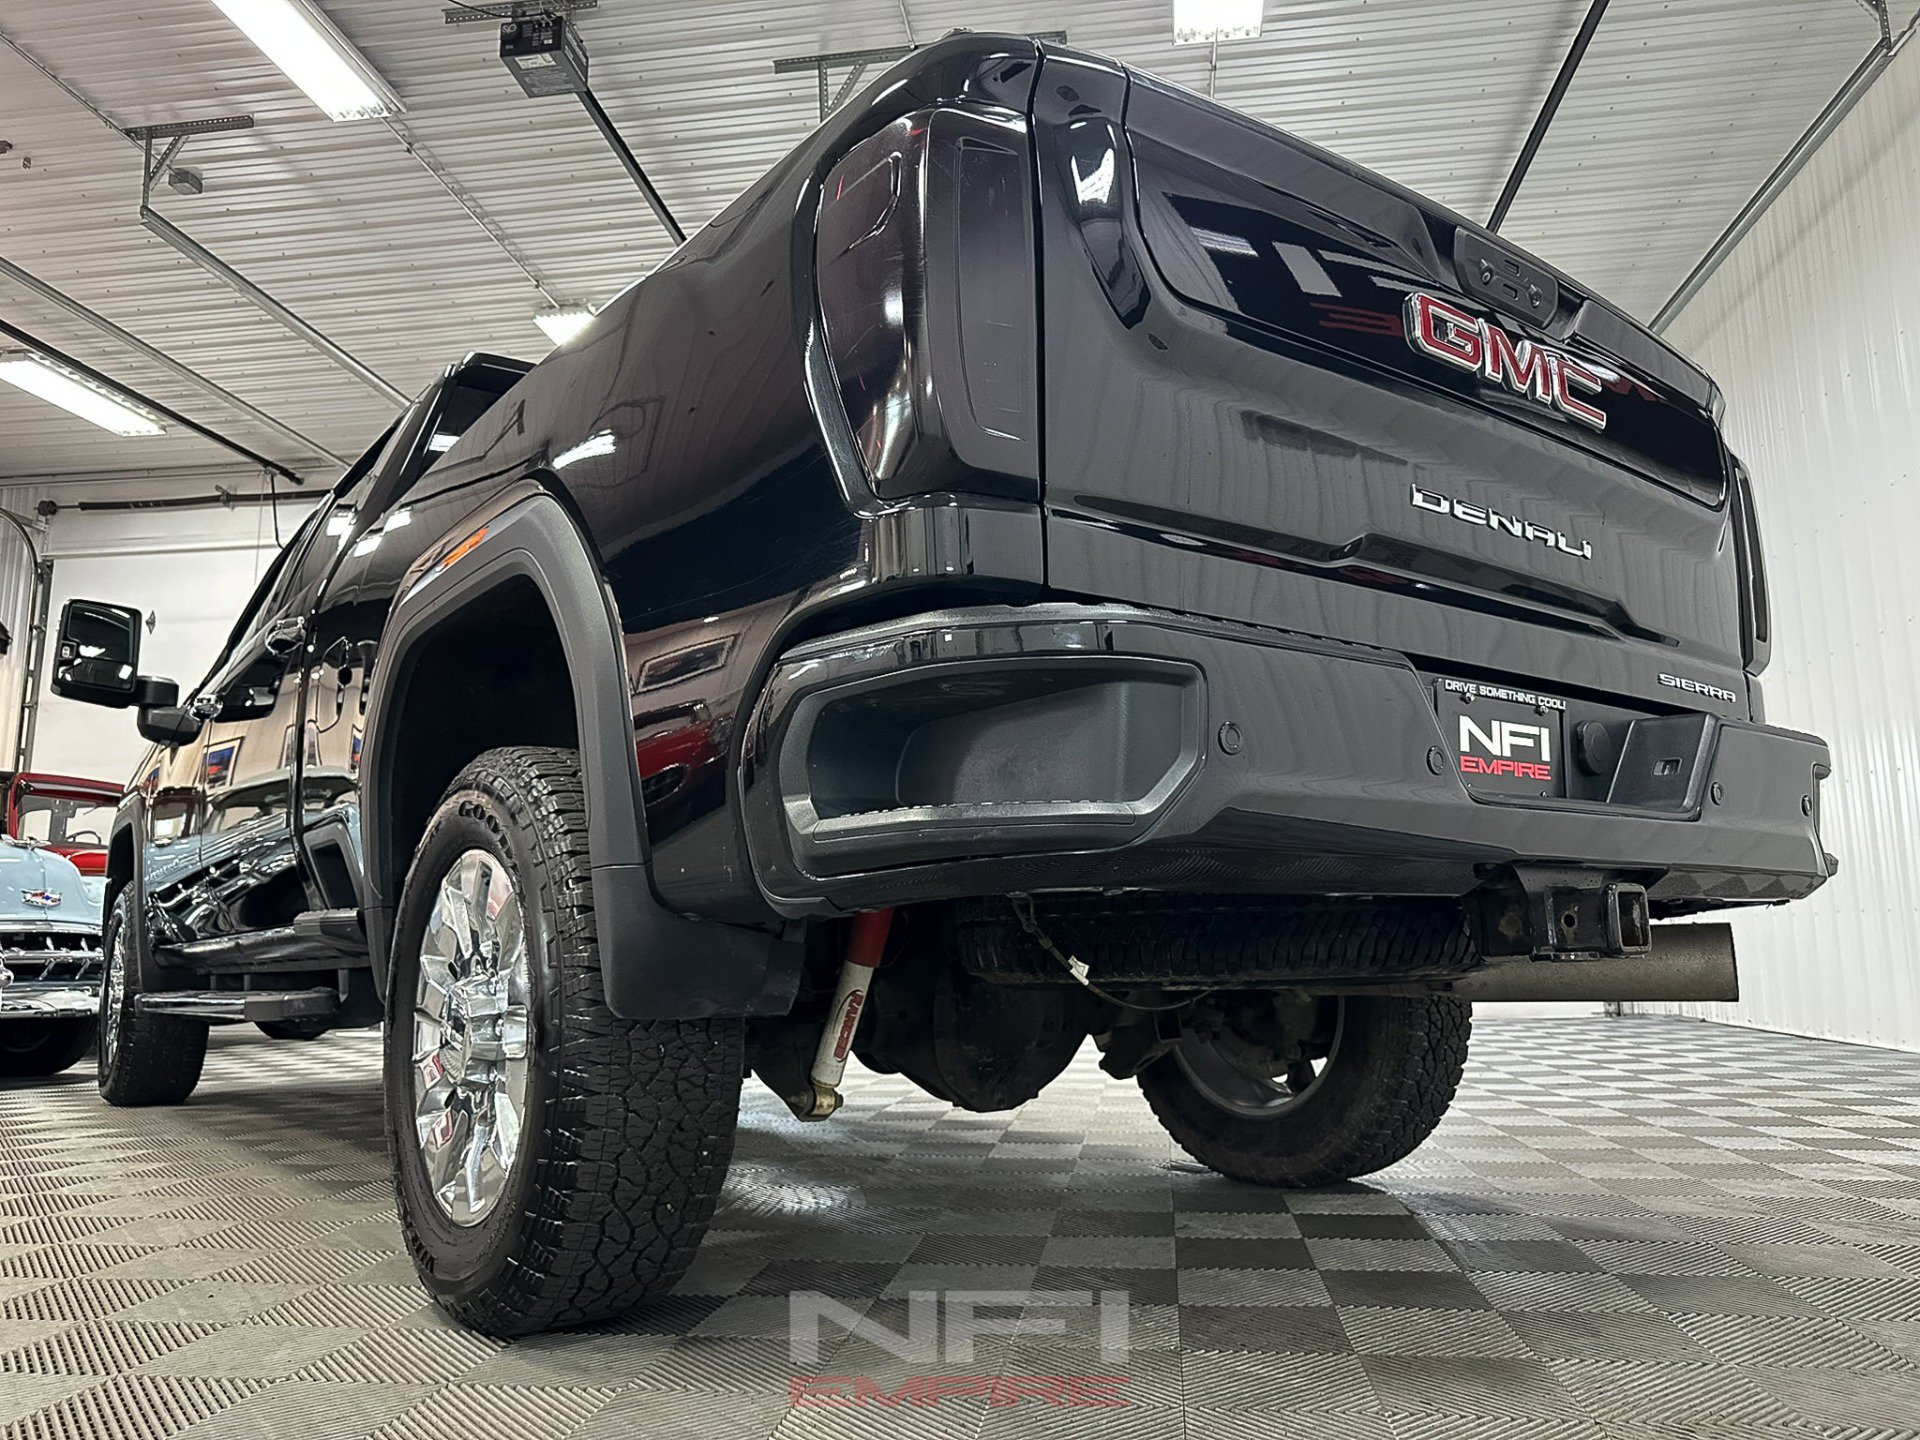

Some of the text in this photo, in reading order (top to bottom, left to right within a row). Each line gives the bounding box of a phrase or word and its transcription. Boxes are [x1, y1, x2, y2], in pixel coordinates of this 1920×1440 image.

[1403, 292, 1606, 432] GMC
[1410, 484, 1592, 559] DENALI
[1445, 679, 1566, 710] DRIVE SOMETHING COOL!
[1658, 673, 1736, 702] SIERRA
[1458, 714, 1551, 761] NFI
[1459, 755, 1552, 780] EMPIRE
